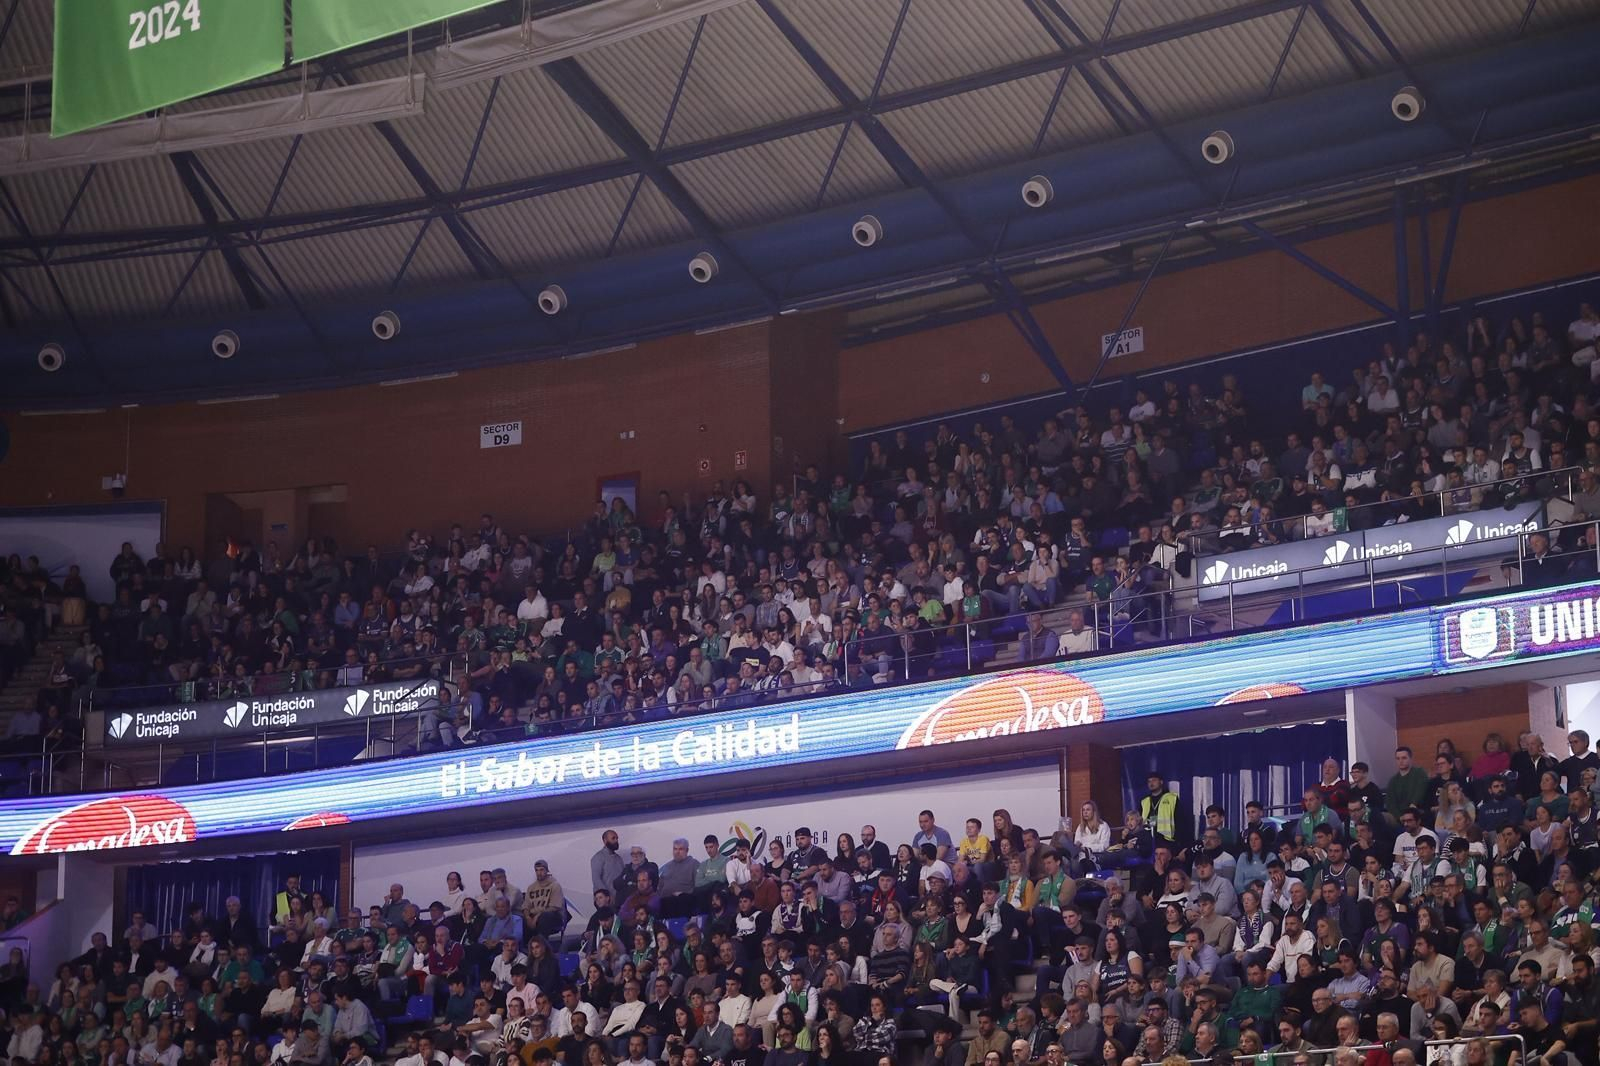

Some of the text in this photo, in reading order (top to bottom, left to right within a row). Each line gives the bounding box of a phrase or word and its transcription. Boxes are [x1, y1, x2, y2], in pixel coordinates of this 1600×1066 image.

[129, 0, 201, 50] 2024
[1115, 341, 1131, 355] A1
[483, 422, 520, 435] SECTOR
[494, 433, 511, 446] D9
[1353, 539, 1413, 561] Unicaja
[1231, 559, 1288, 581] Unicaja
[1530, 596, 1600, 646] UNI
[252, 696, 315, 714] Fundación
[136, 708, 197, 726] Fundación
[252, 711, 297, 727] Unicaja
[136, 722, 180, 739] Unicaja
[440, 713, 801, 798] El Sabor de la Calidad
